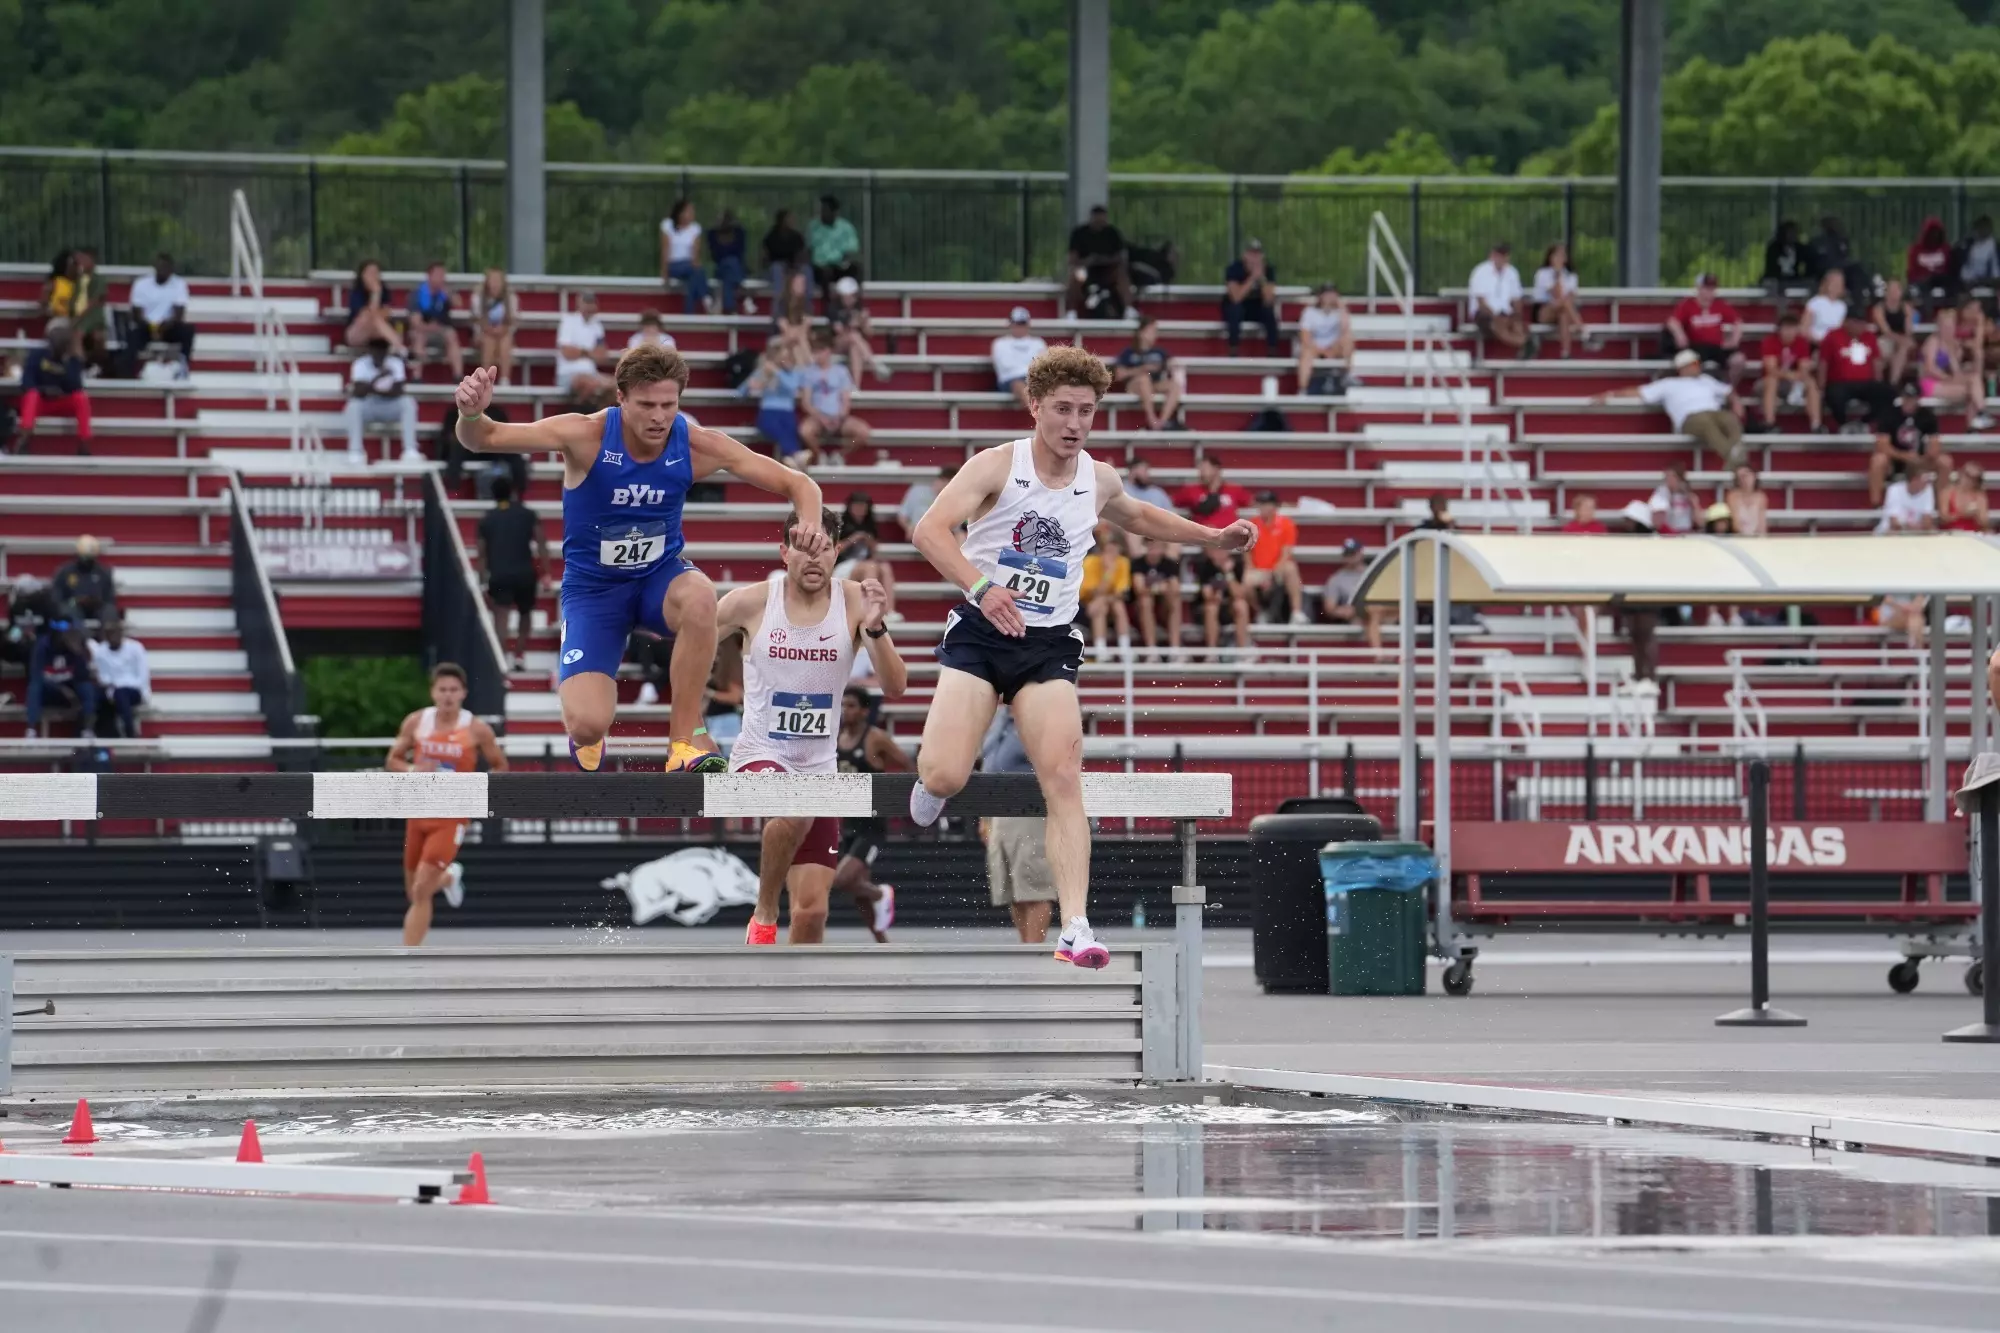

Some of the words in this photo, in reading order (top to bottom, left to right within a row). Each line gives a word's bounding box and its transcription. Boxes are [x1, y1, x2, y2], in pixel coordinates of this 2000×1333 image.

[611, 484, 666, 507] BYU
[613, 541, 654, 563] 247
[1006, 573, 1050, 604] 429
[771, 628, 787, 644] SEC
[768, 645, 838, 662] SOONERS
[776, 711, 827, 733] 1024
